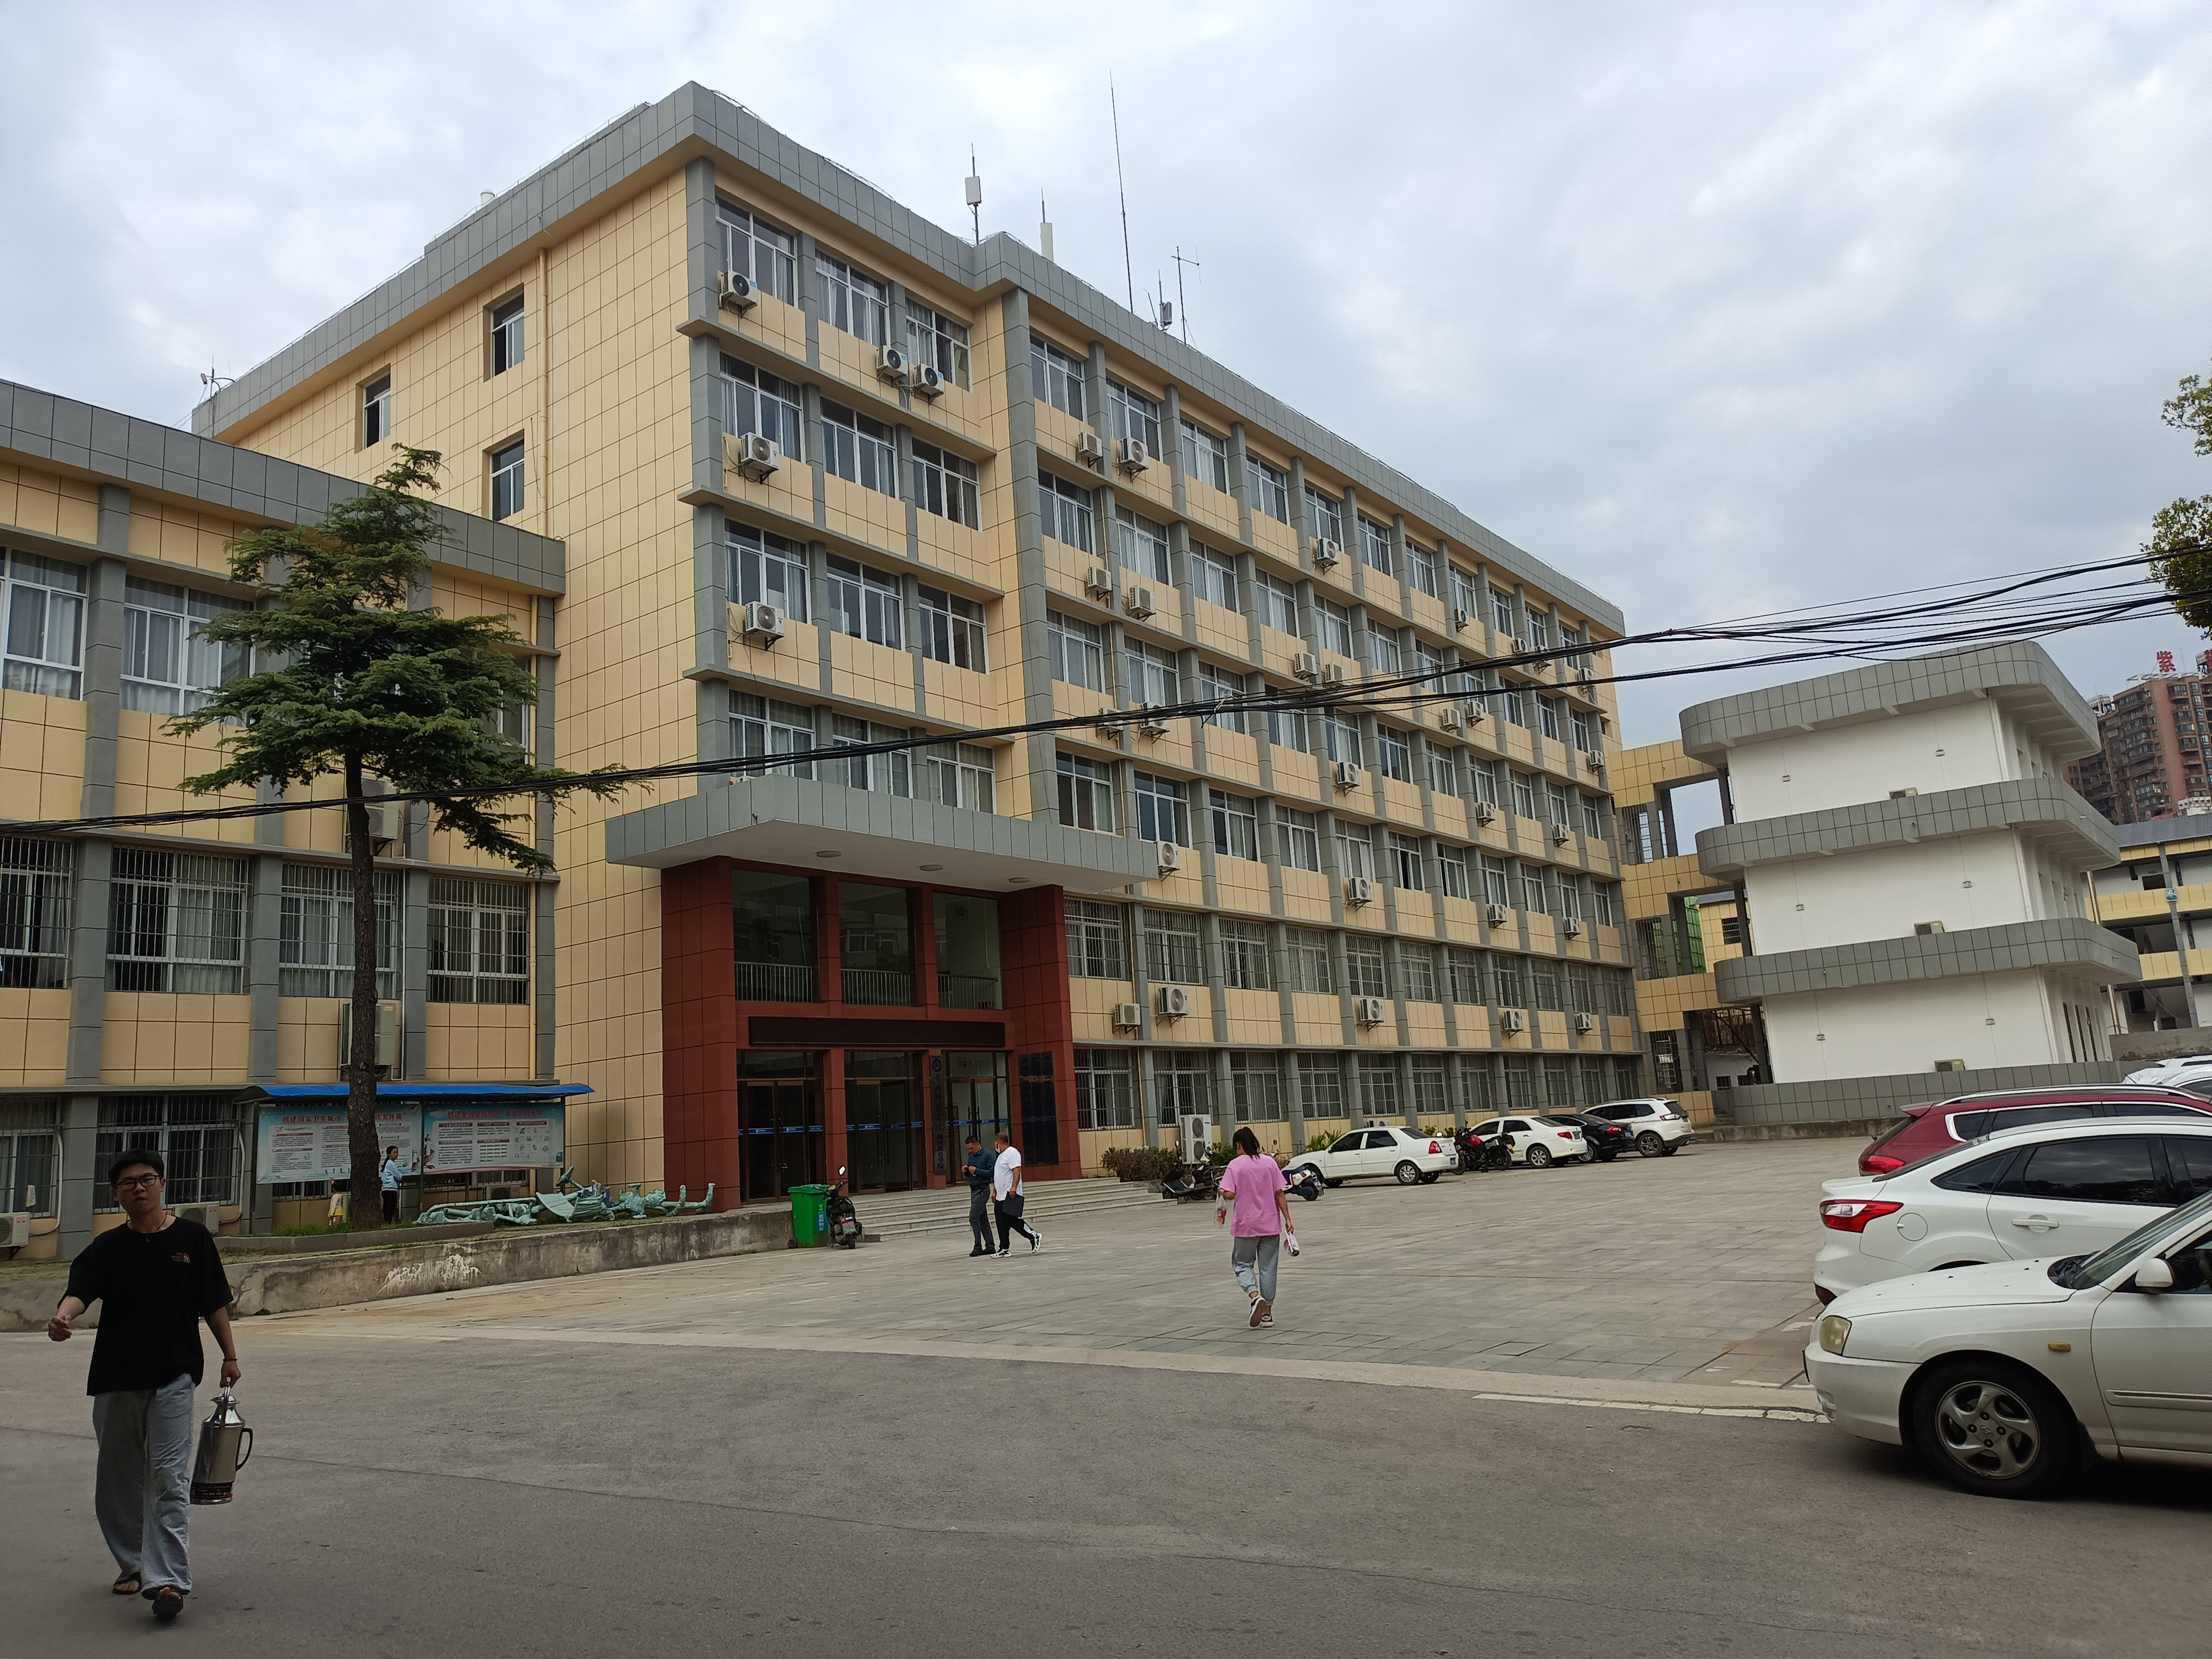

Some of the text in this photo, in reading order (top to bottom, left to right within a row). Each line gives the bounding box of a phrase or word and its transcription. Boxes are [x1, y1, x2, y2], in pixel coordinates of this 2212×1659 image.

[2157, 651, 2176, 672] 紫
[282, 1115, 341, 1123] 创建国家卫生城市
[447, 1109, 542, 1119] 创建全国文明城市 争当文明市民
